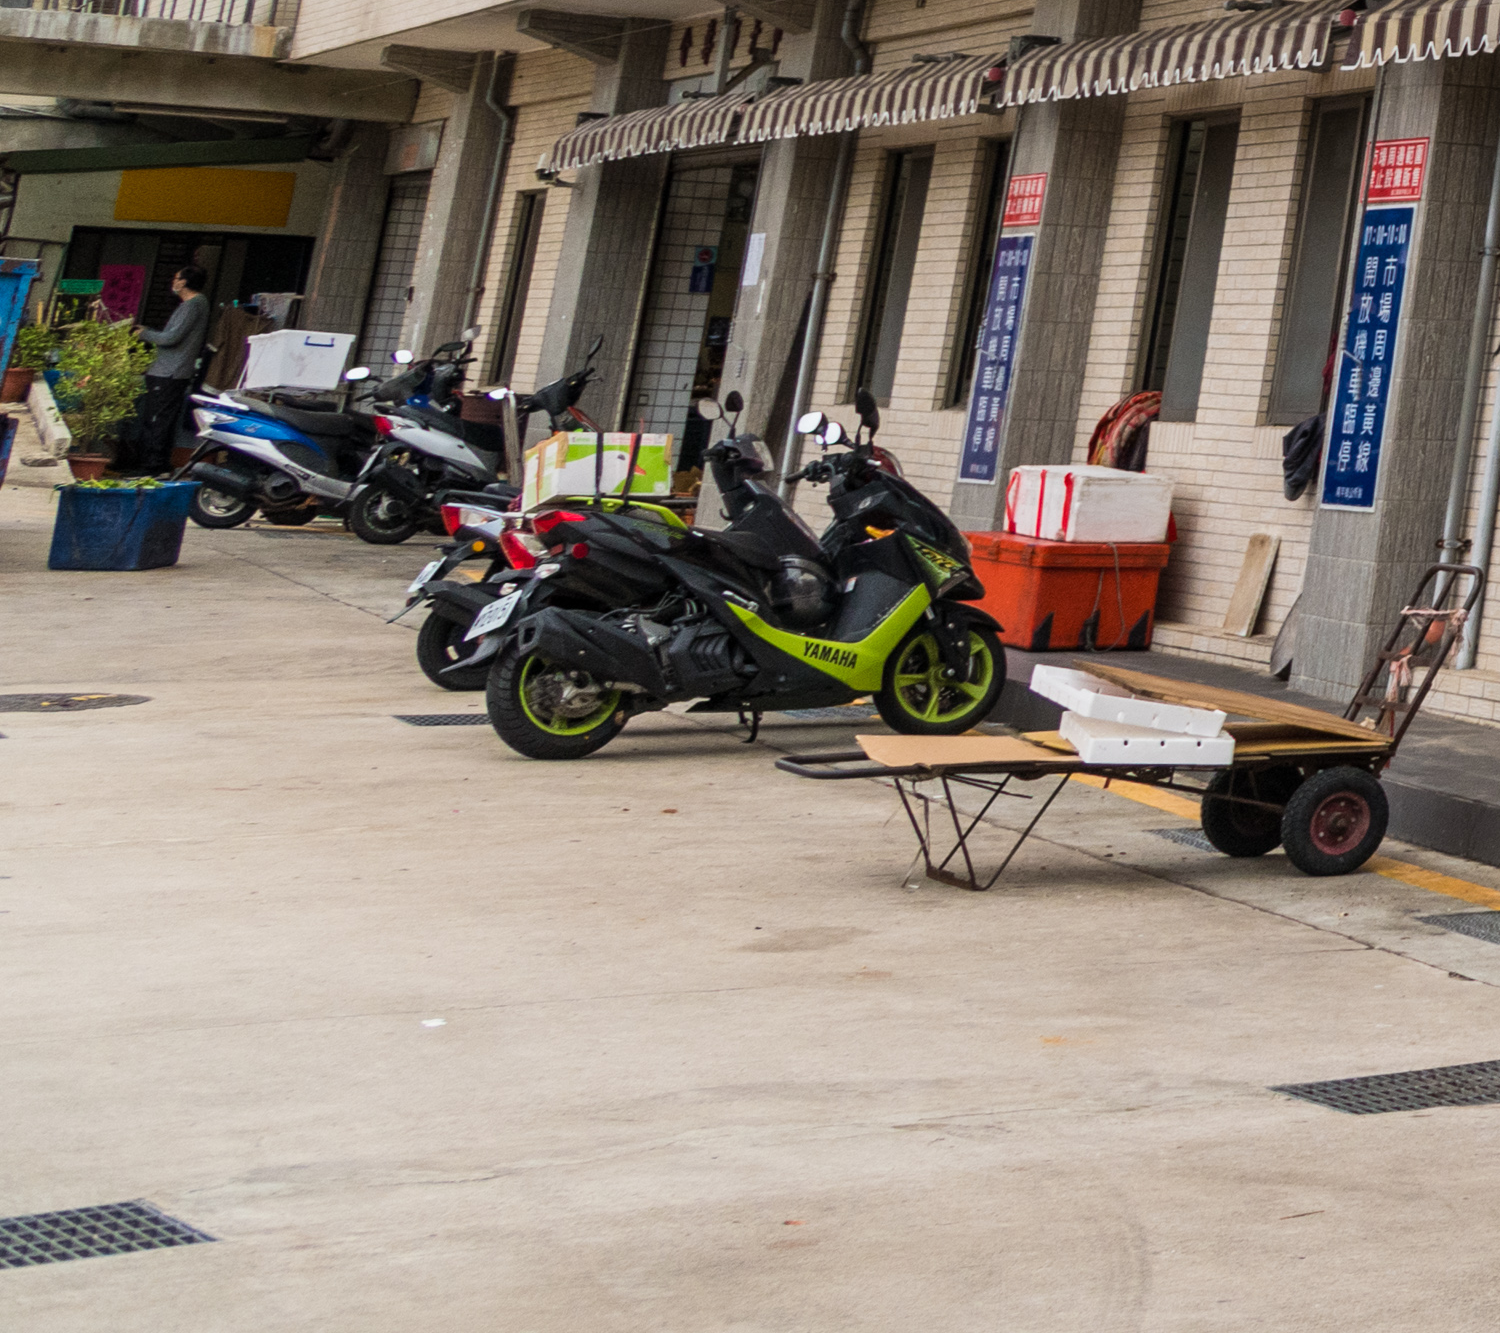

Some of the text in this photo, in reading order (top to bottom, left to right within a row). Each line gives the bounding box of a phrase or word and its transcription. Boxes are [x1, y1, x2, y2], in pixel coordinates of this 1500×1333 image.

[1355, 255, 1398, 474] 市場周邊黃線
[803, 640, 858, 670] YAMAHA
